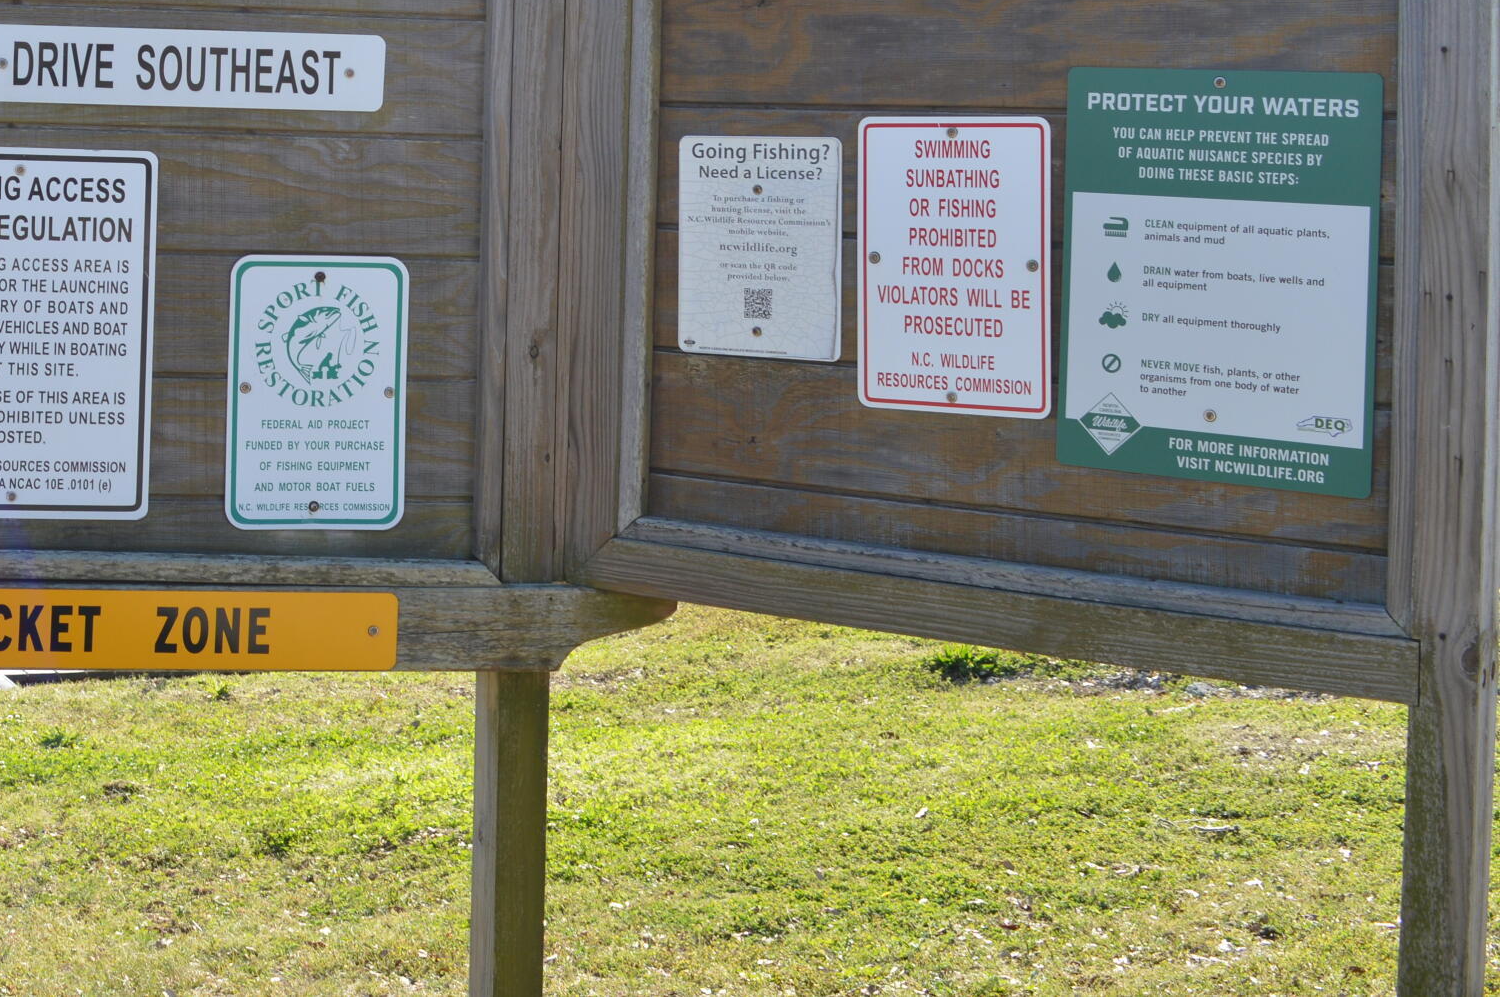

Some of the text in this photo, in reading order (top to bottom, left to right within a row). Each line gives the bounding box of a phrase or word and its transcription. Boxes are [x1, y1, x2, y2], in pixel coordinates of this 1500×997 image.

[13, 41, 114, 88] DRIVE
[136, 45, 341, 95] SOUTHEAST
[1088, 93, 1359, 117] PROTECT YOUR WATERS
[1113, 127, 1329, 146] YOU CAN HELP PREVENT THE SPREAD
[692, 143, 829, 164] Going Fishing?
[915, 140, 990, 159] SWIMMING
[1119, 147, 1322, 166] OF AQUATIC NUISANCE SPECIES BY
[700, 165, 822, 180] Need a License?
[906, 169, 999, 188] SUNBATHING
[1139, 167, 1298, 185] DOING THESE BASIC STEPS:
[28, 177, 125, 203] ACCESS
[910, 198, 996, 218] OR FISHING
[910, 228, 996, 248] PROHIBITED
[720, 242, 797, 257] ncwildlife.org
[12, 258, 68, 272] ACCESS
[74, 259, 111, 273] AREA
[117, 260, 129, 273] IS
[903, 257, 1003, 278] FROM DOCKS
[22, 279, 47, 292] THE
[52, 280, 128, 294] LAUNCHING
[258, 280, 378, 333] SPORT FISH
[878, 285, 1030, 309] VIOLATORS WILL BE
[24, 300, 41, 313] OF
[48, 301, 93, 314] BOATS
[100, 302, 128, 315] AND
[63, 322, 89, 335] AND
[94, 322, 127, 335] BOAT
[905, 315, 1003, 337] PROSECUTED
[10, 342, 49, 355] WHILE
[54, 342, 65, 355] IN
[71, 343, 126, 356] BOATING
[8, 362, 38, 376] THIS
[45, 363, 78, 376] SITE.
[912, 352, 994, 370] N.C. WILDLIFE
[255, 340, 379, 407] RESTORATION
[878, 372, 1031, 395] RESOURCES COMMISSION
[262, 420, 369, 429] FEDERAL AID PROJECT
[1314, 418, 1347, 431] DEQ
[246, 441, 384, 450] FUNDED BY YOUR PURCHASE
[1169, 437, 1329, 465] FOR MORE INFORMATION
[260, 461, 370, 471] OF FISHING EQUIPMENT
[1177, 456, 1324, 483] VISIT NCWILDLIFE.ORG
[254, 482, 375, 491] AND MOTOR BOAT FUELS
[154, 607, 270, 654] ZONE
